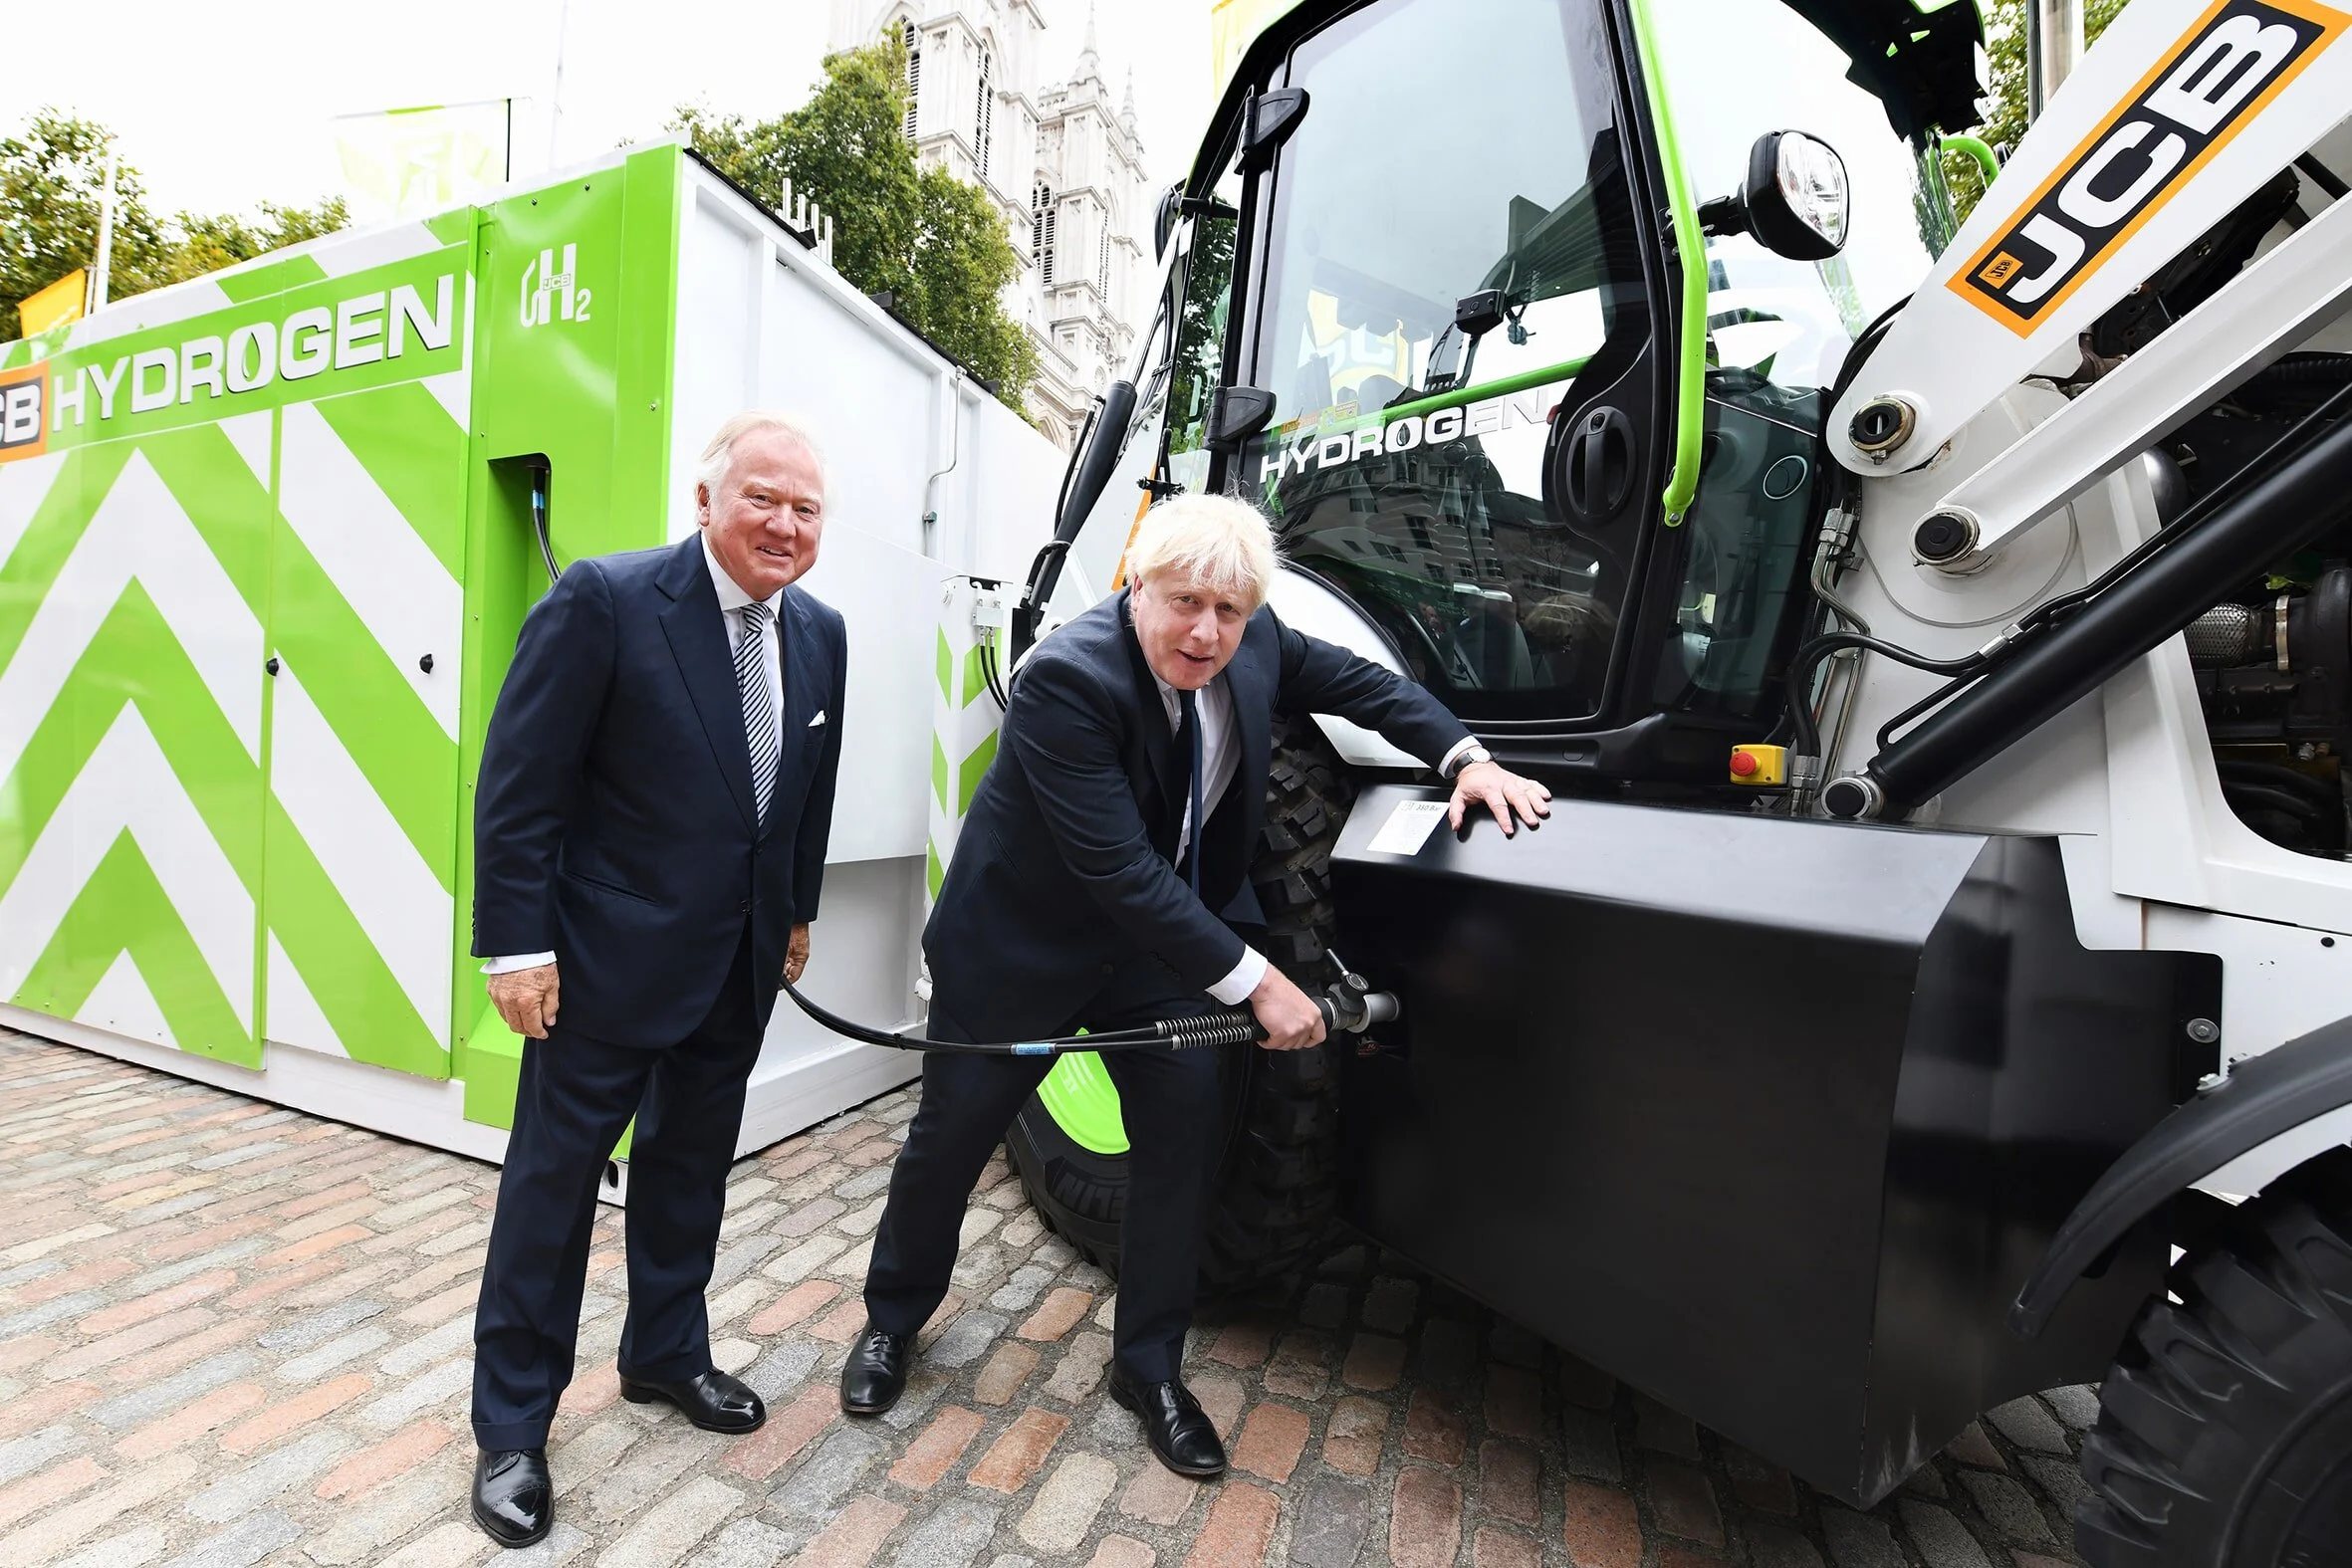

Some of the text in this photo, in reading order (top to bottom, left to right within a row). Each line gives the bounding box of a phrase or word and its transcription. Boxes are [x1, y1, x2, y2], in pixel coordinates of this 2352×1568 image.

[2006, 14, 2298, 304] JCB
[542, 274, 571, 291] JCB
[1990, 261, 2011, 279] JCB
[0, 273, 455, 443] B HYDROGEN
[1260, 385, 1549, 484] HYDROGEN
